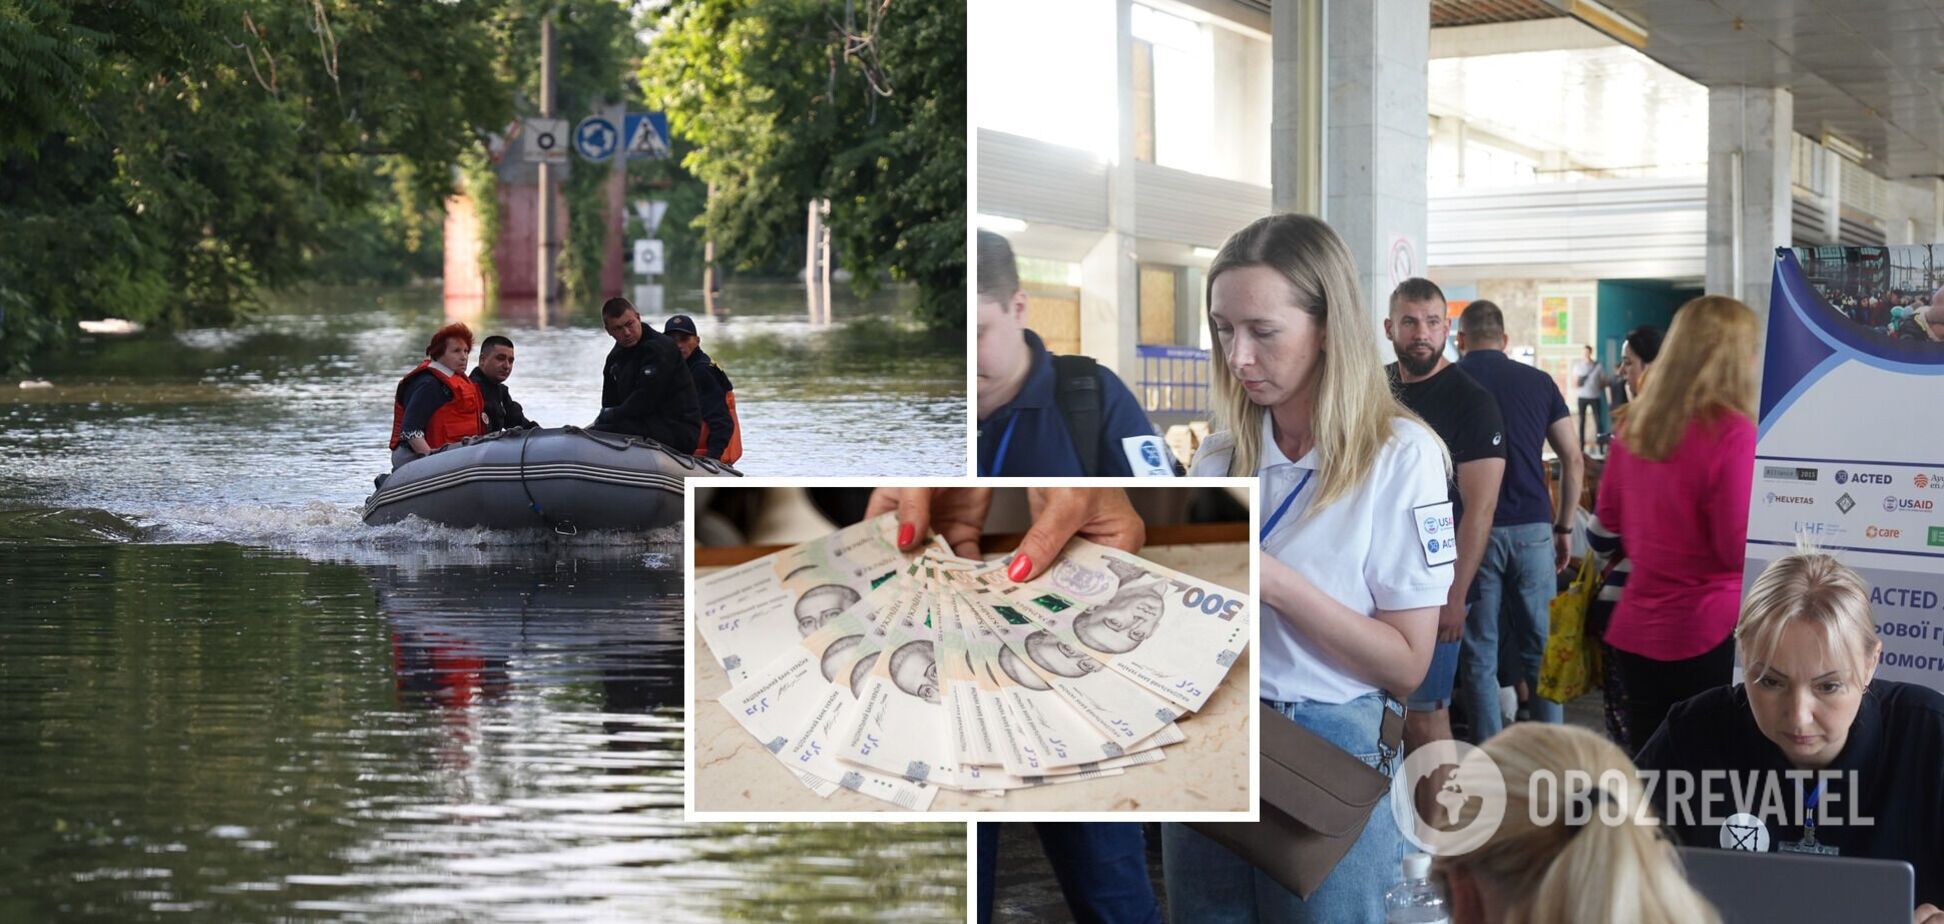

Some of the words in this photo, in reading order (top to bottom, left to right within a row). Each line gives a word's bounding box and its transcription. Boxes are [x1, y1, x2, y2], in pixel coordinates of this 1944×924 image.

[1851, 473, 1893, 485] ACTED
[1775, 495, 1814, 505] HELVETAS
[1899, 499, 1933, 510] USAID
[1794, 521, 1824, 535] UHF
[1878, 528, 1900, 538] care
[1182, 586, 1244, 622] 500
[1870, 586, 1938, 609] ACTED
[1933, 627, 1944, 646] г
